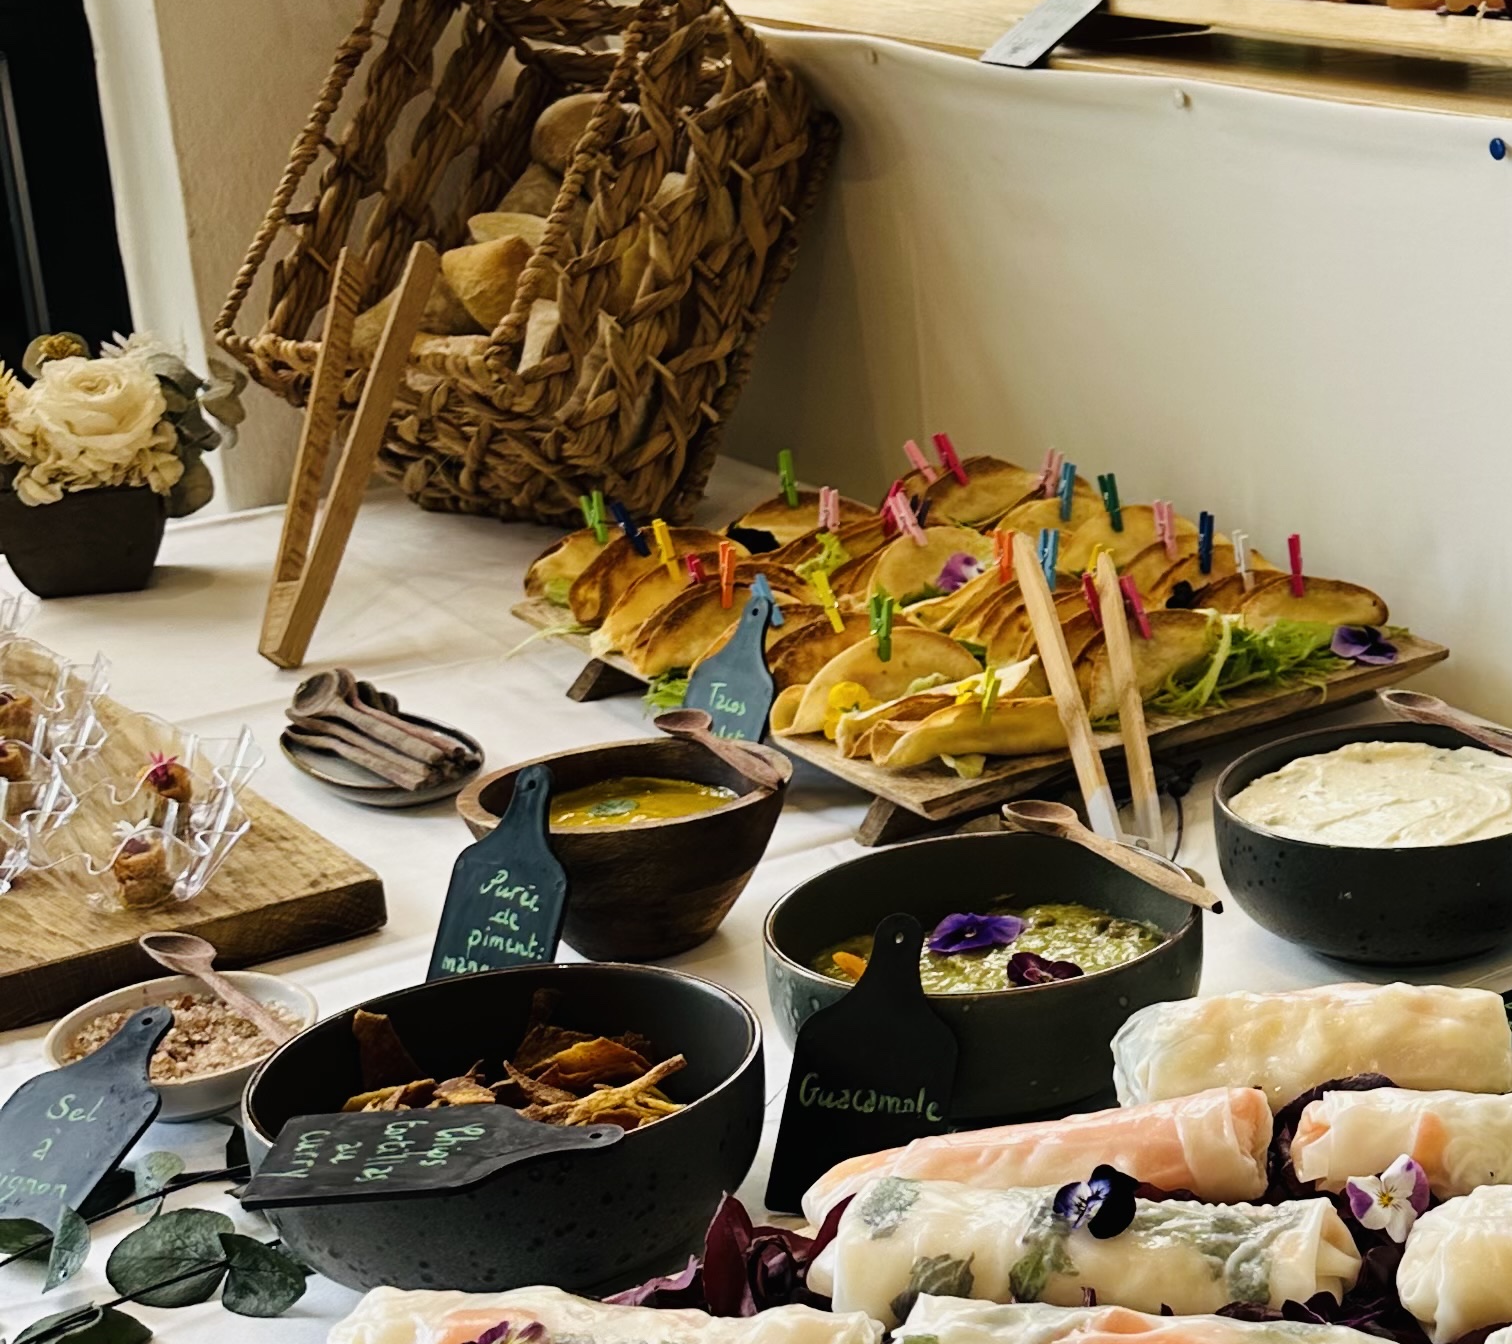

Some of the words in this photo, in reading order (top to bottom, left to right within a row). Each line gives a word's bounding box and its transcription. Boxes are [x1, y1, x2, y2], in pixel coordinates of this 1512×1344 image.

[709, 682, 747, 717] Tacos
[489, 908, 520, 931] de
[47, 1093, 105, 1123] Sel
[798, 1072, 943, 1122] Guacamole
[329, 1141, 363, 1165] au
[354, 1120, 430, 1183] tortillas
[408, 1123, 485, 1167] Chips
[0, 1168, 68, 1204] ignon
